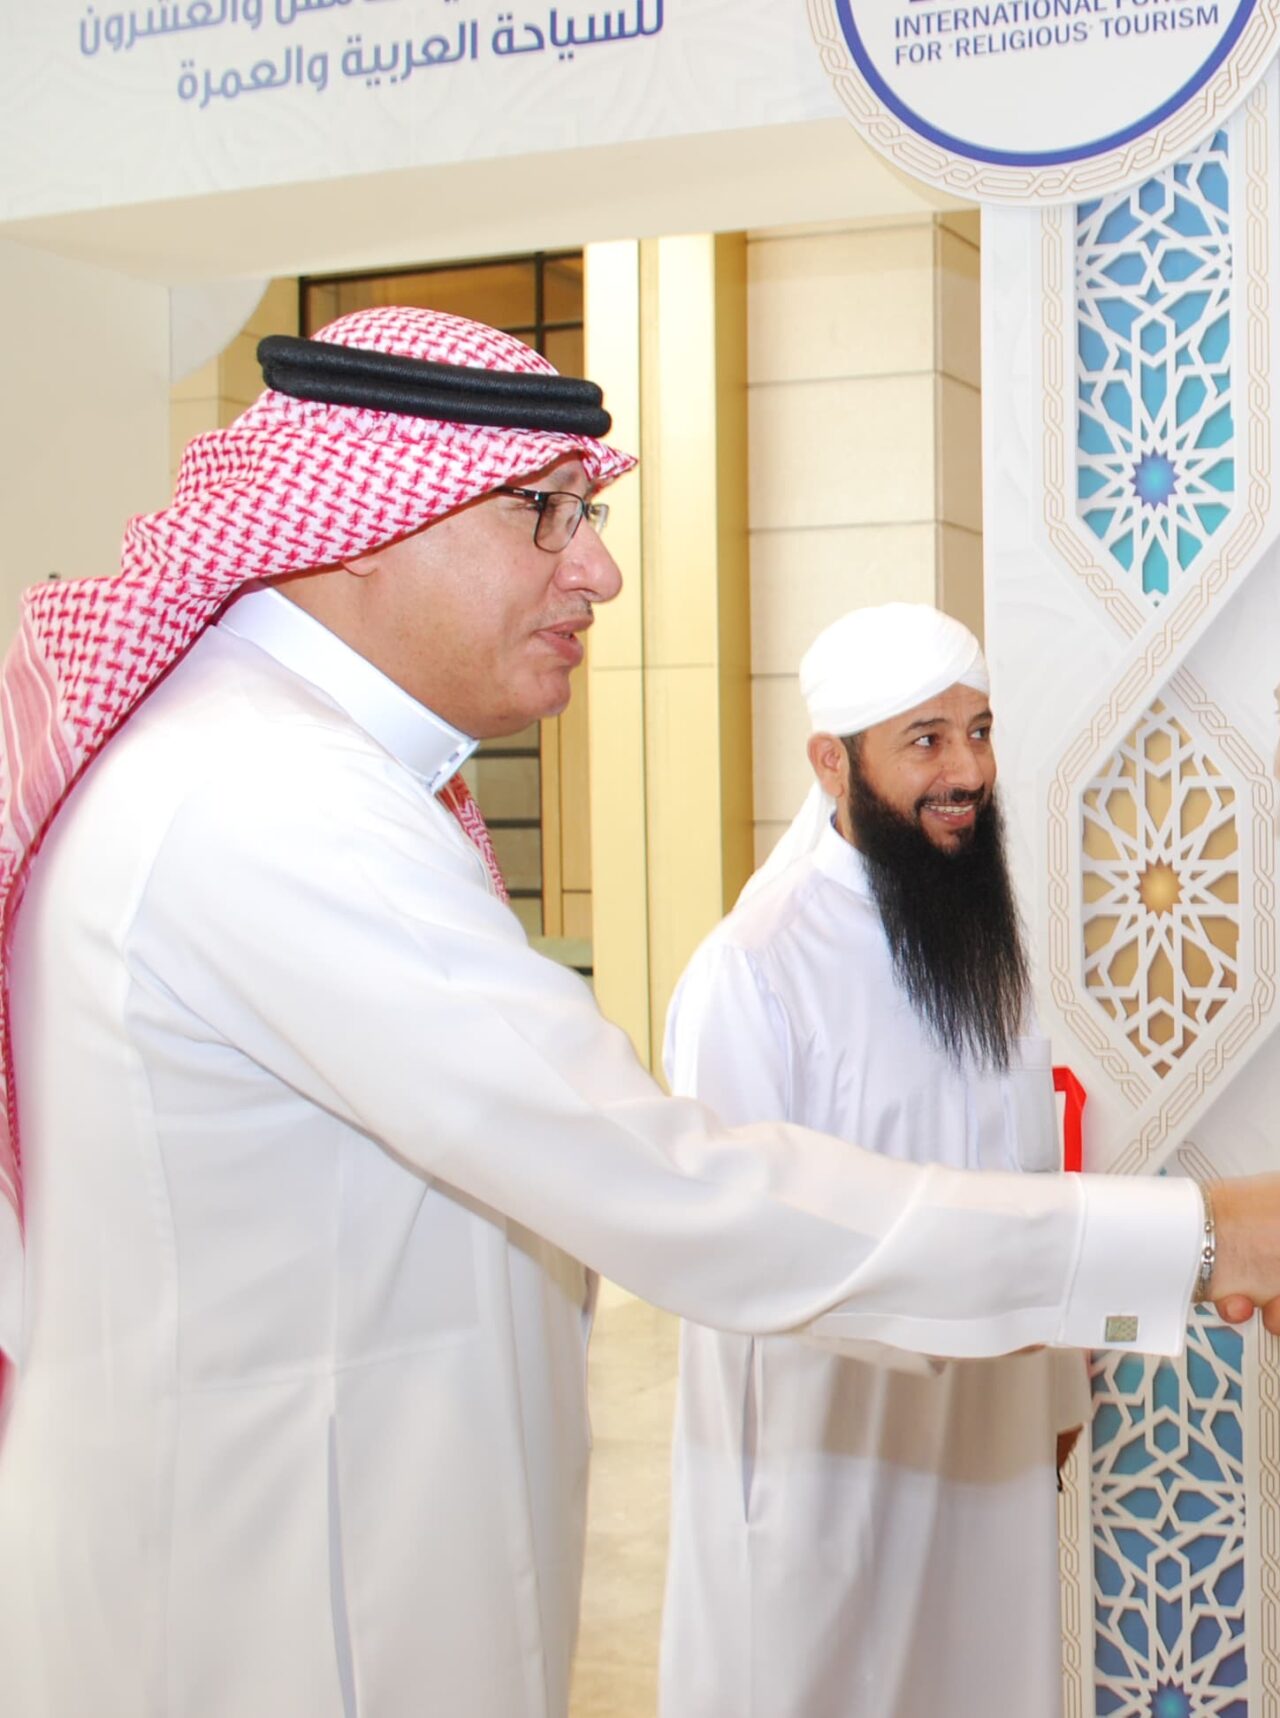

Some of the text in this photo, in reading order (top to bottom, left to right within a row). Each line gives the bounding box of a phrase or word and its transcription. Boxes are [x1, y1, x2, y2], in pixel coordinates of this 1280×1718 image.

[895, 0, 1108, 39] INTERNATIONAL
[895, 4, 1219, 66] FOR RELIGIOUS TOURISM
[177, 0, 664, 109] للسياحة العربية والعمرة
